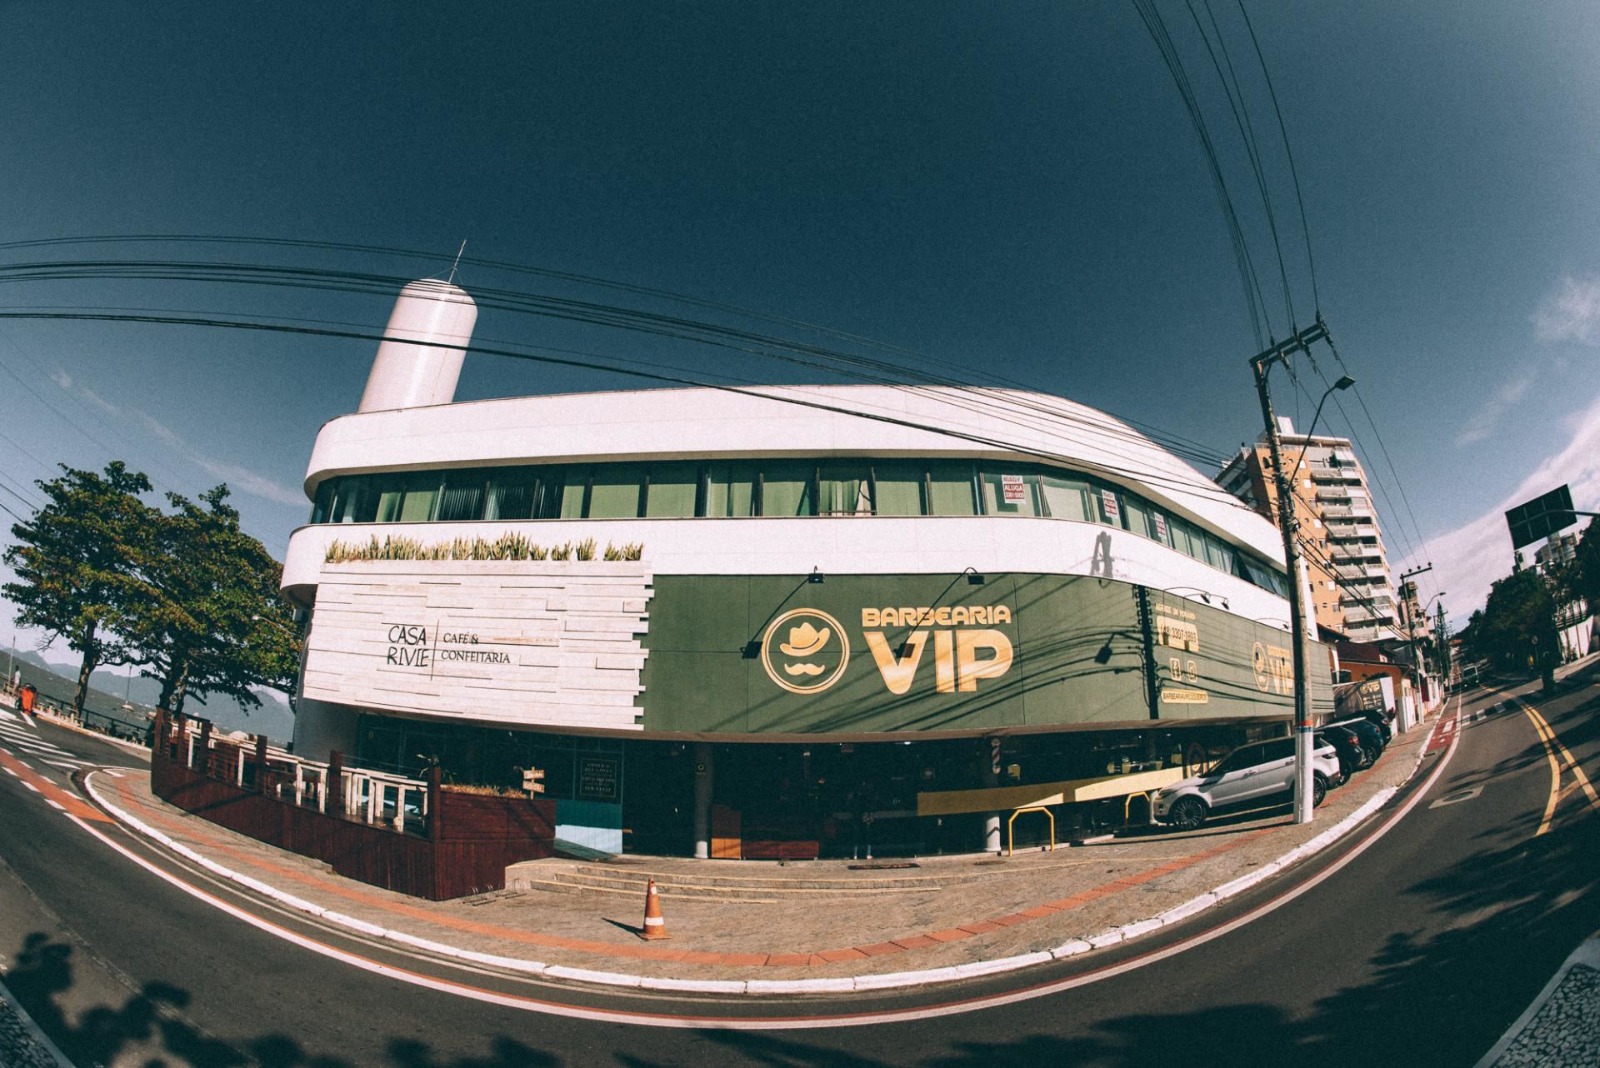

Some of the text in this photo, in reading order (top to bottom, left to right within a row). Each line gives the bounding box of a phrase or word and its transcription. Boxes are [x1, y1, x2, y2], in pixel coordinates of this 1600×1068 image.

[861, 605, 1012, 627] BARBEARIA
[388, 625, 426, 645] CASA
[443, 631, 479, 645] CAFÉ &
[387, 646, 429, 667] RIVIE
[441, 650, 511, 664] CONFEITARIA
[863, 629, 1014, 695] VIP
